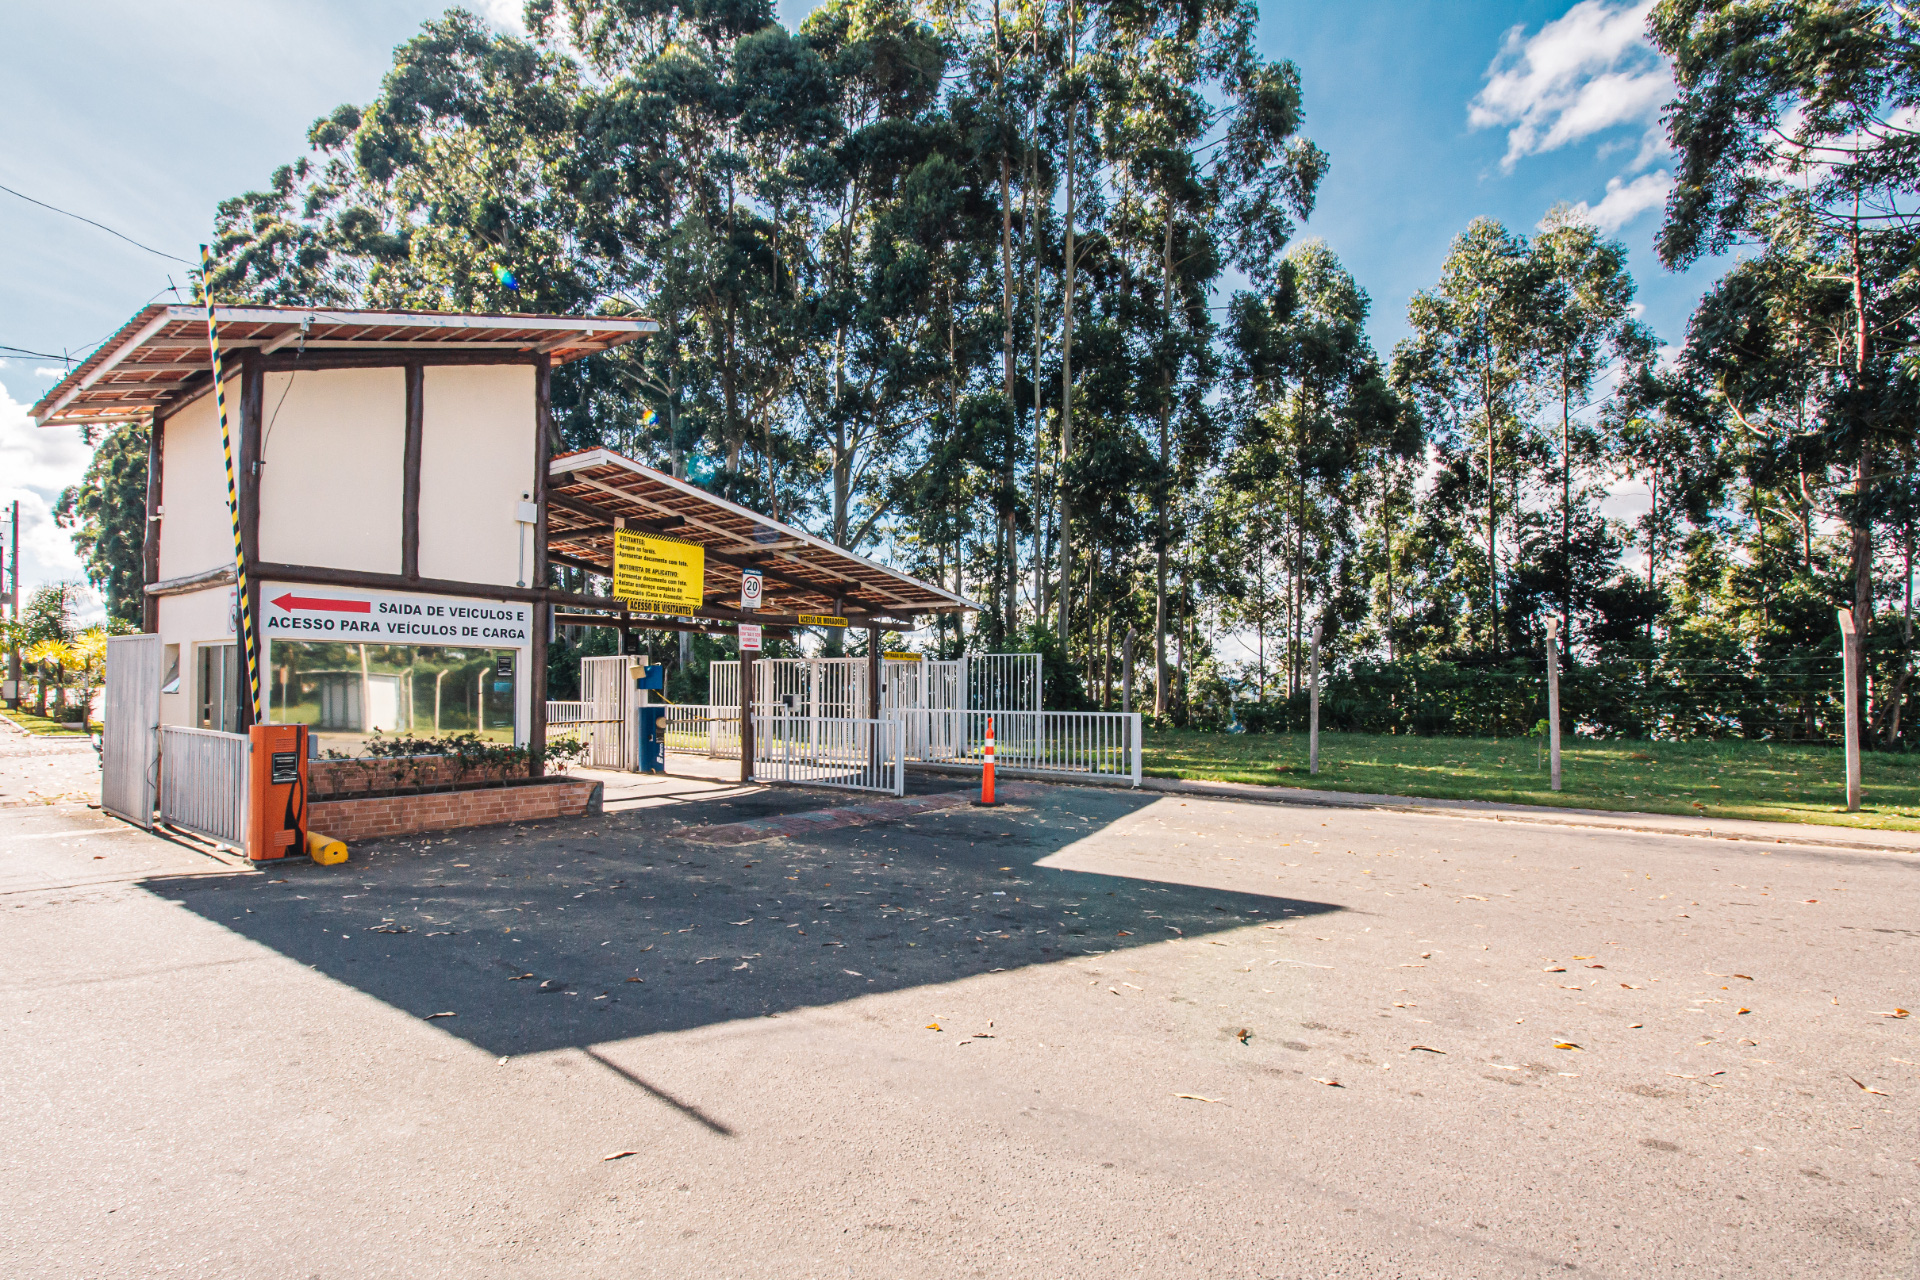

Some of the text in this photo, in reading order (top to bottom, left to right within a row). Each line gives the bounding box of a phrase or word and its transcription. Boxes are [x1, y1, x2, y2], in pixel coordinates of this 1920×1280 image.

[644, 555, 667, 564] documento
[619, 564, 644, 573] MOTORISTA
[619, 572, 642, 580] Apresentar
[643, 575, 667, 584] documento
[746, 580, 758, 591] 20
[379, 602, 524, 621] SAIDA DE VEICULOS E
[630, 601, 691, 615] ACESSO DE VISITANTES
[268, 616, 525, 639] ACESSO PARA VEÍCULOS DE CARGA
